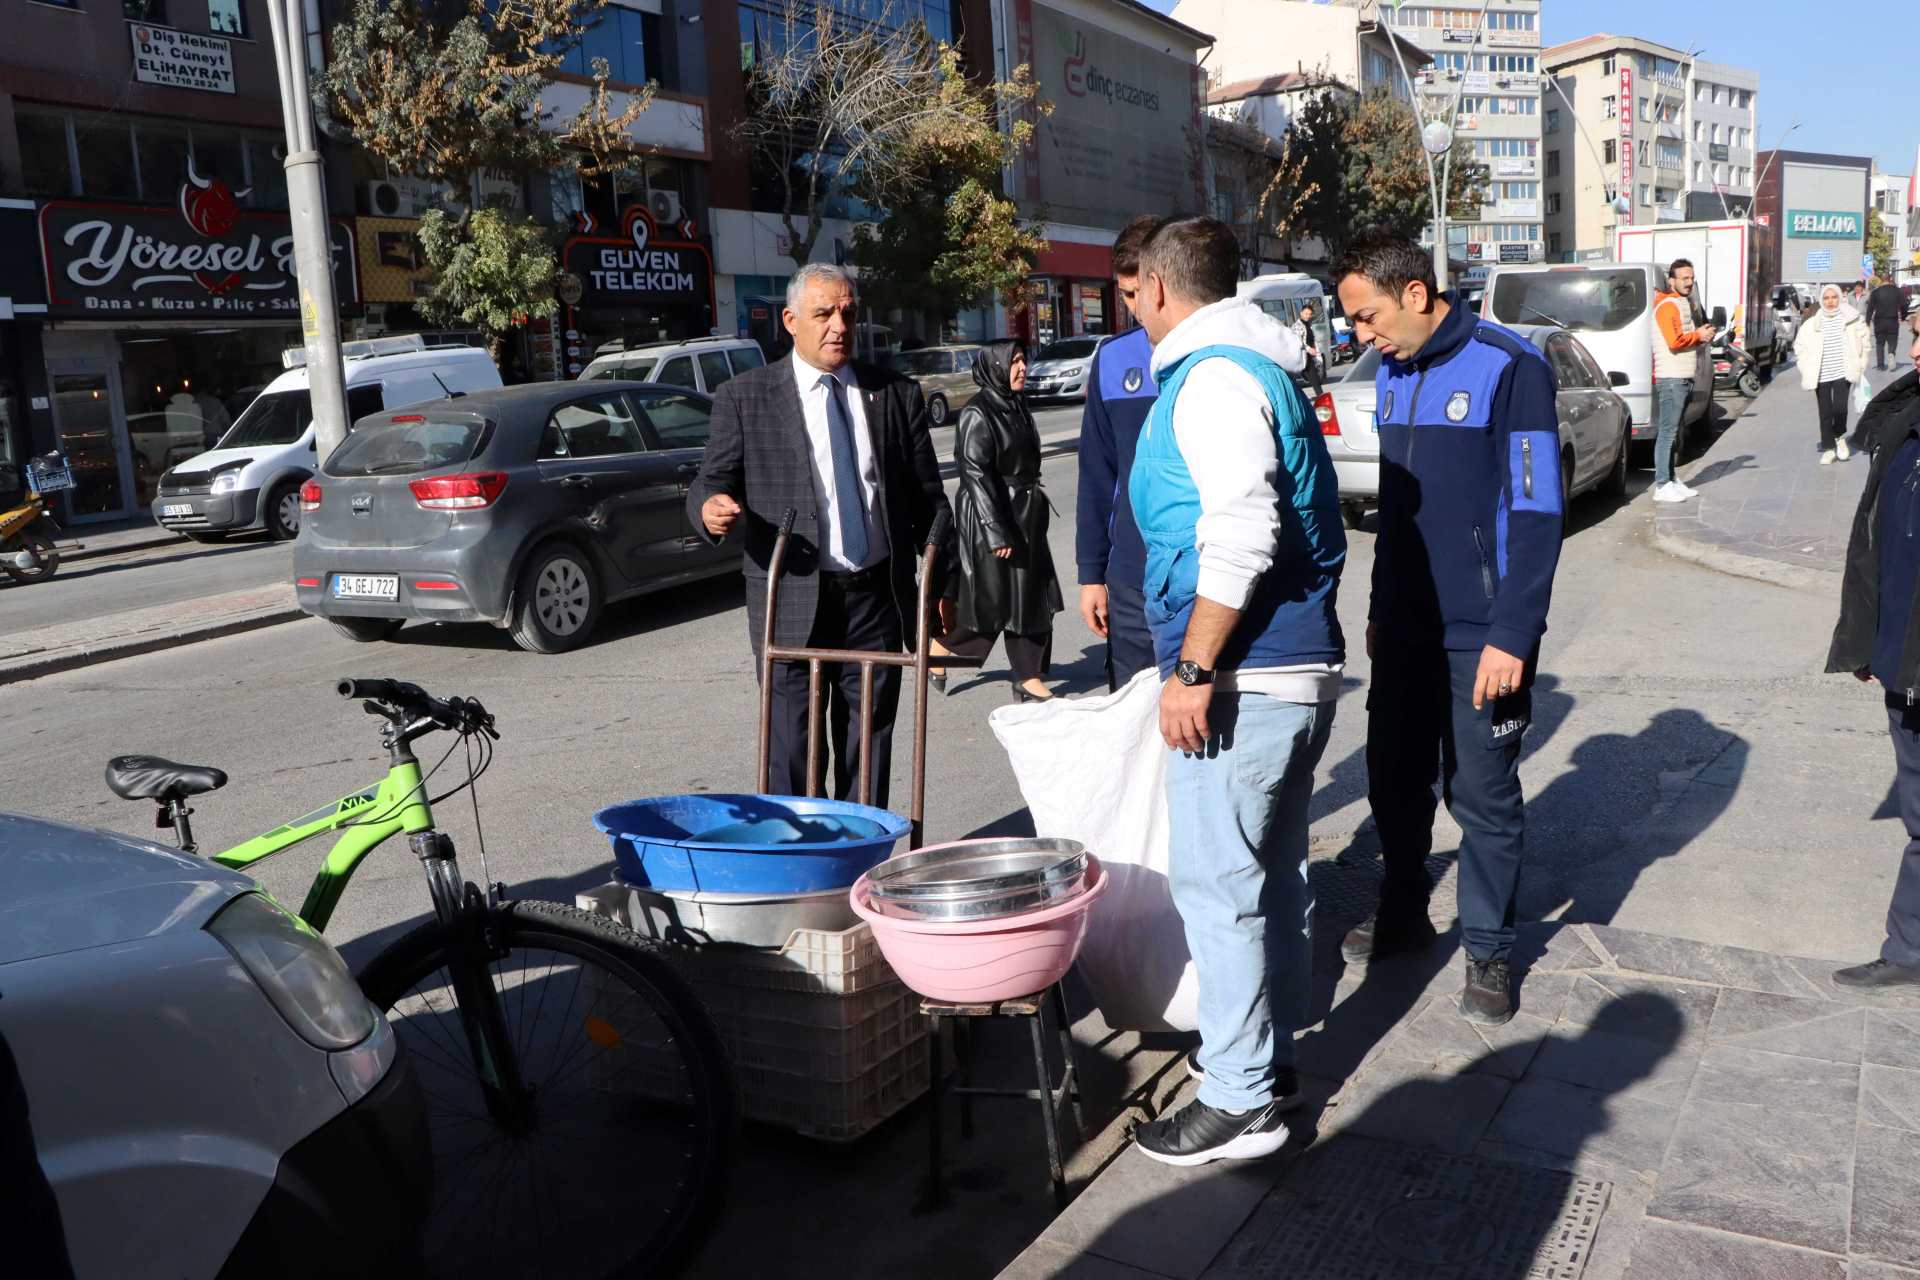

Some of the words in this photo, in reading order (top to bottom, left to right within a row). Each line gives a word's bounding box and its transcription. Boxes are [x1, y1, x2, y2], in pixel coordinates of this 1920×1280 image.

[180, 34, 228, 51] Hekimi
[170, 47, 225, 66] Cüneyt
[1086, 65, 1112, 104] dinç
[1794, 215, 1857, 233] BELLONA
[64, 220, 265, 286] Yöresel
[590, 270, 694, 290] TELEKOM
[85, 296, 132, 310] Dana
[152, 296, 195, 310] Kuzu
[212, 295, 253, 312] Piliç
[341, 577, 352, 593] 34
[355, 578, 374, 594] GEJ
[376, 579, 394, 595] 722
